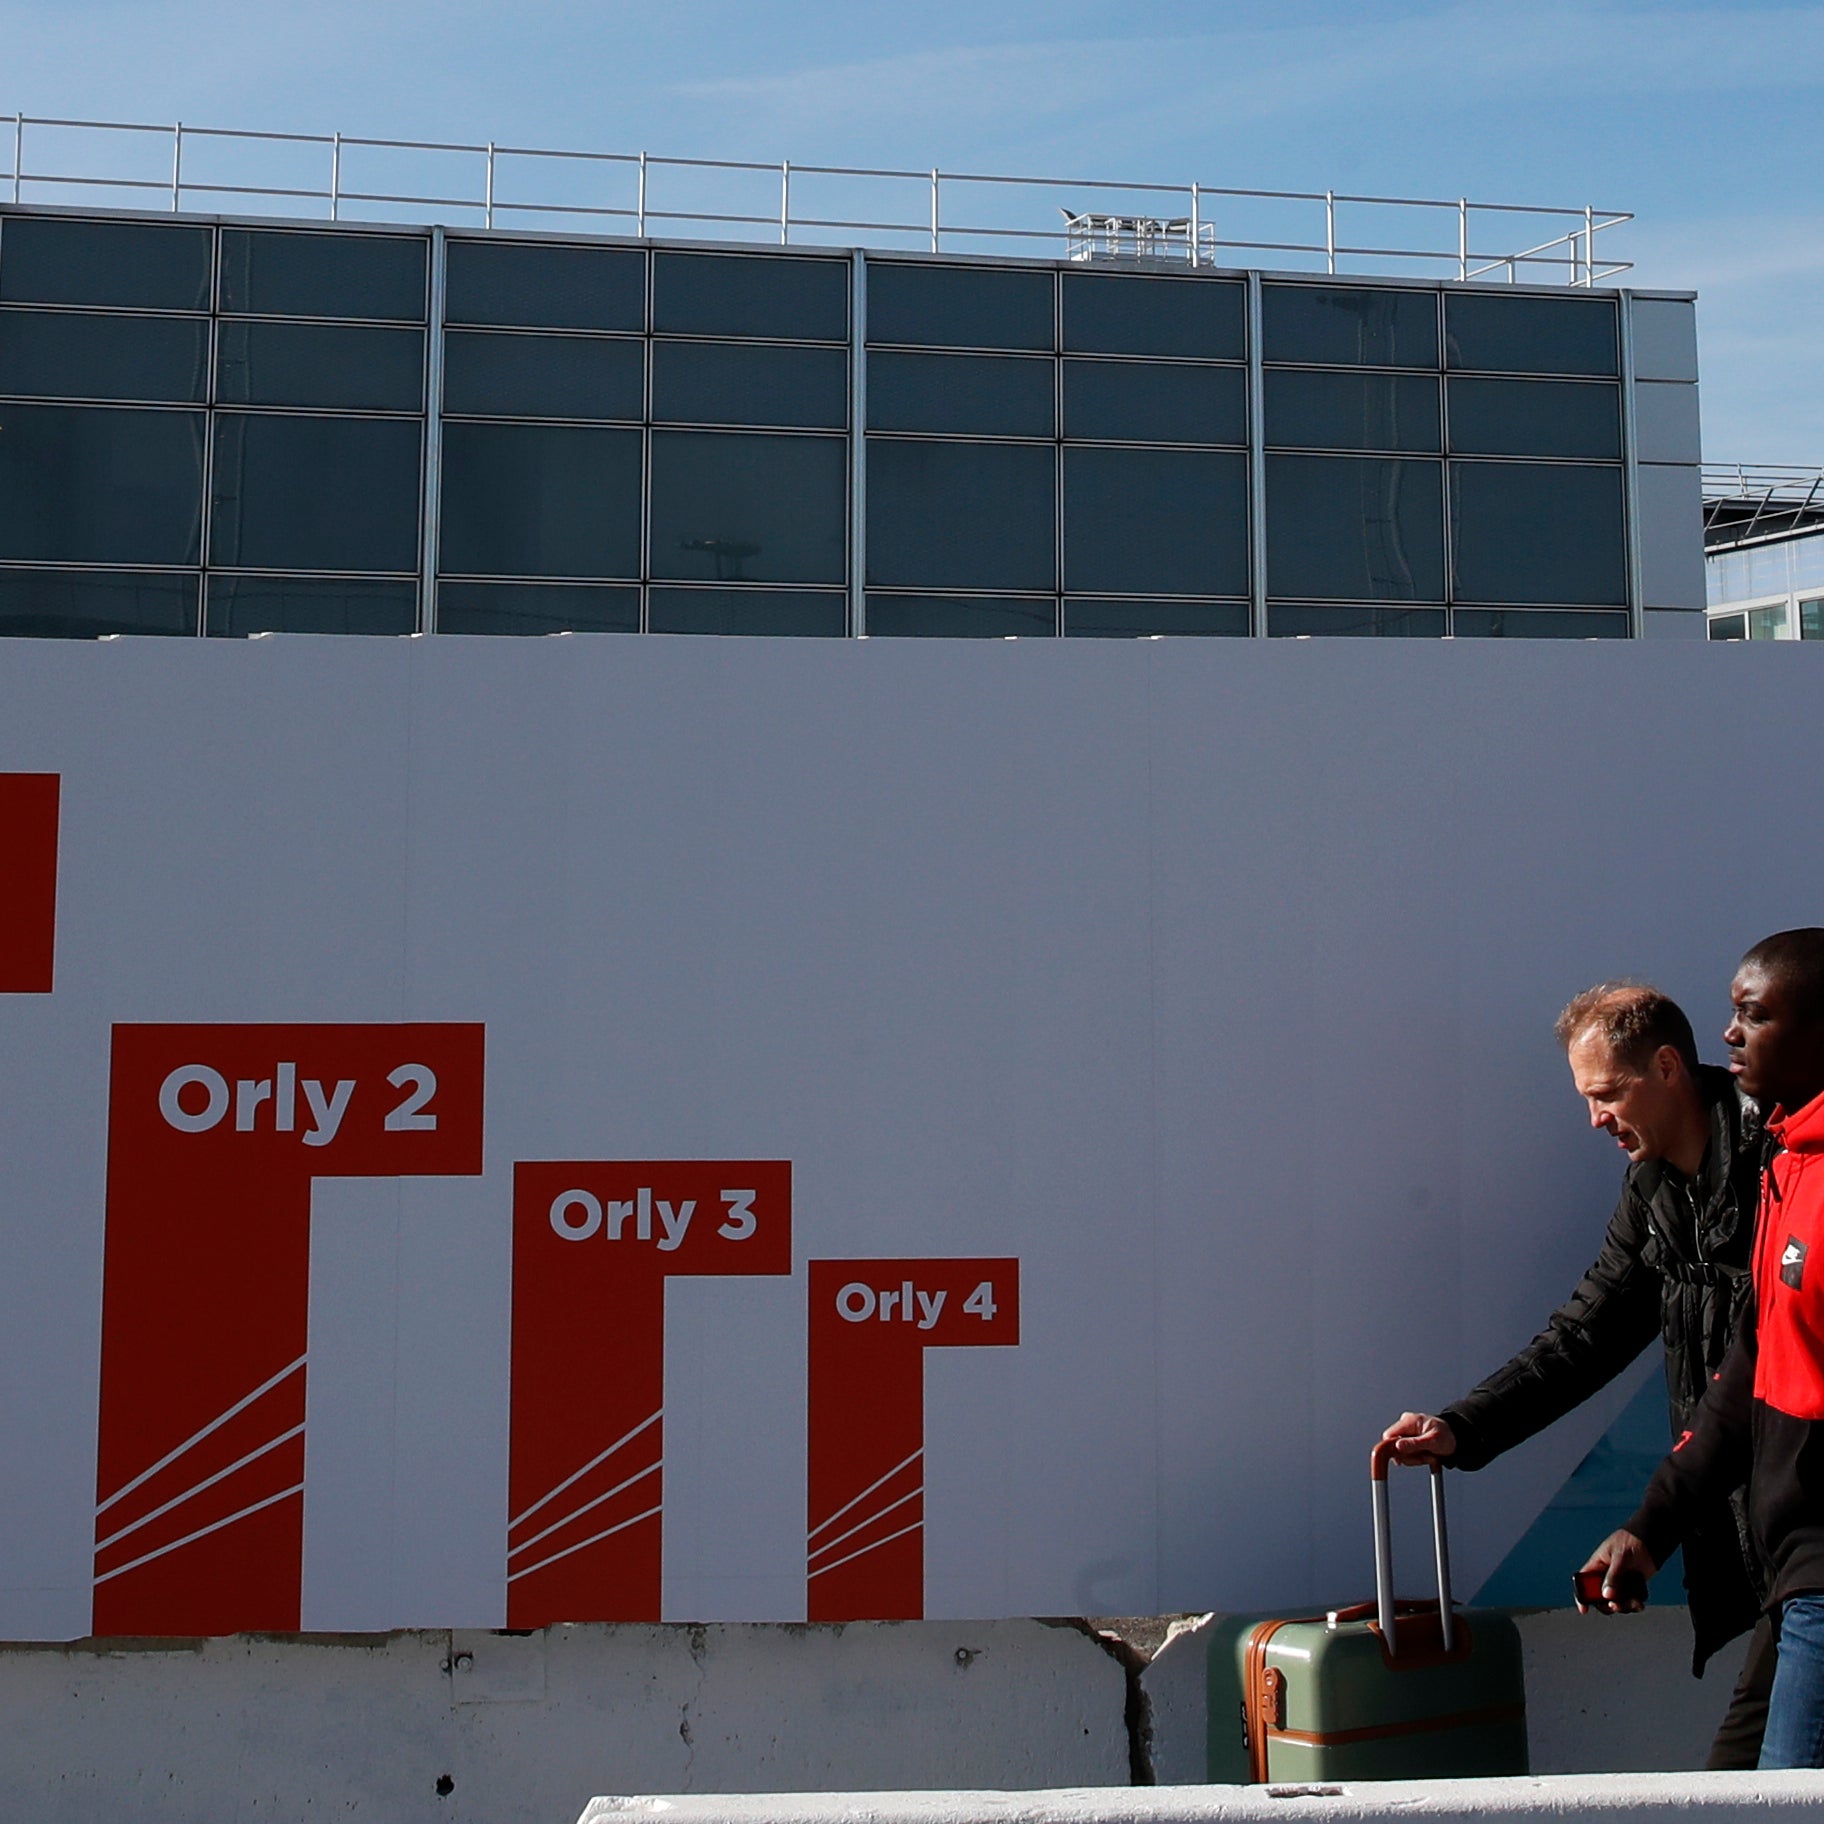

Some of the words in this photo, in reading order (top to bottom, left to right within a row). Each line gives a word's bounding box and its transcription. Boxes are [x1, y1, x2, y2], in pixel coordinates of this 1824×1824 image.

[158, 1061, 357, 1147] Orly
[383, 1063, 438, 1132] 2
[549, 1187, 697, 1252] Orly
[716, 1189, 757, 1241] 3
[835, 1280, 948, 1330] Orly
[962, 1281, 998, 1322] 4
